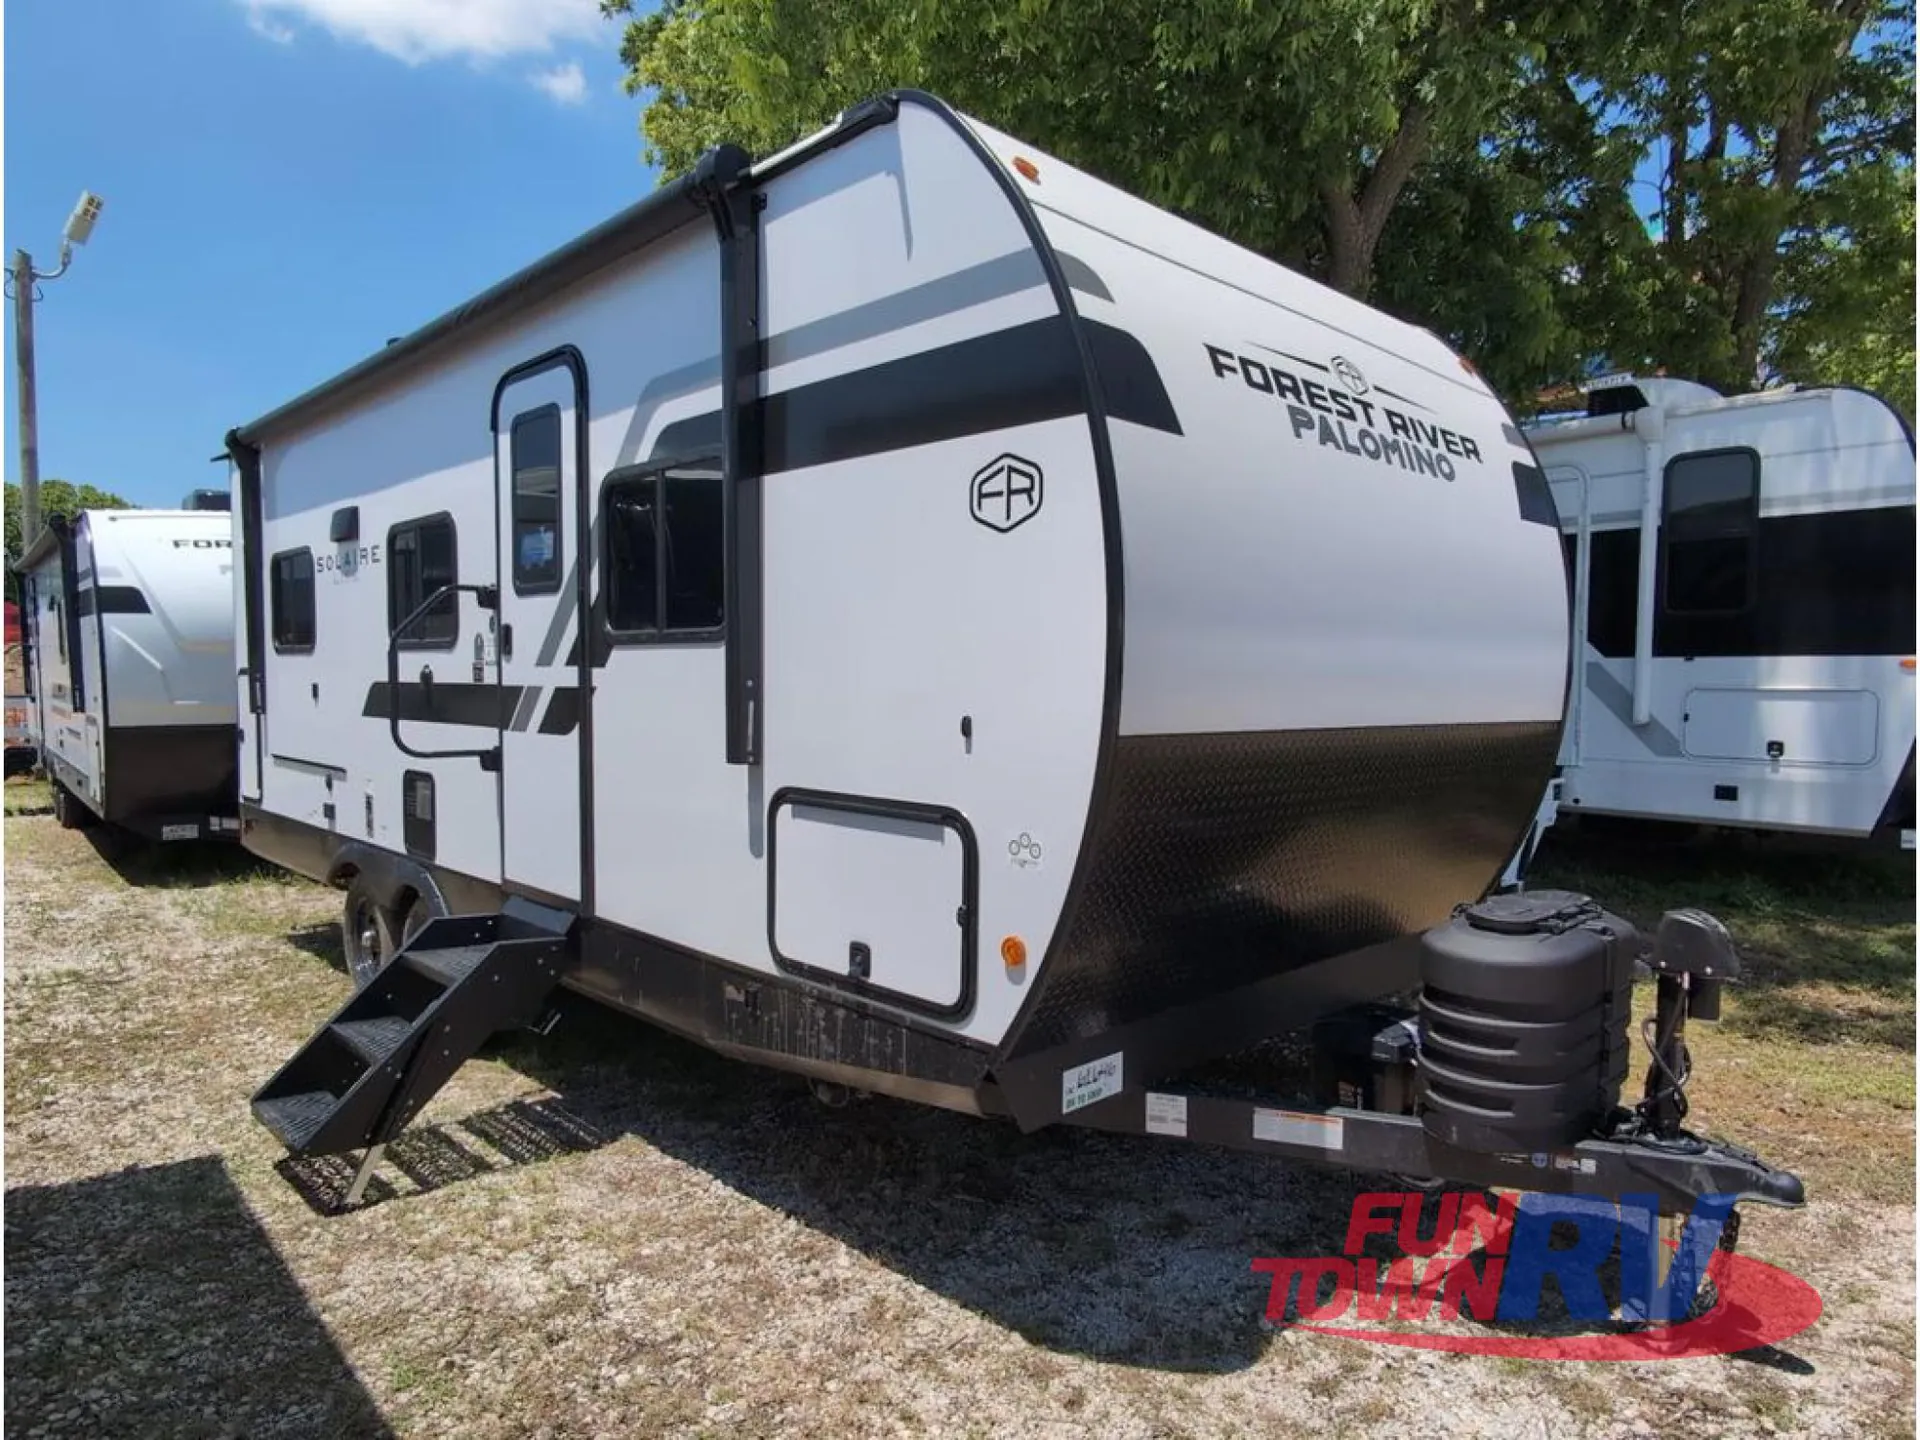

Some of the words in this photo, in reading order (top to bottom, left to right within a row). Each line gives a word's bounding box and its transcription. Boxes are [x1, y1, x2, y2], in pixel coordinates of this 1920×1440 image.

[1202, 342, 1375, 428] FOREST
[1382, 407, 1484, 464] RIVER
[1286, 404, 1456, 483] PALOMINO
[976, 463, 1036, 521] FR
[316, 544, 382, 573] SOLAIRE
